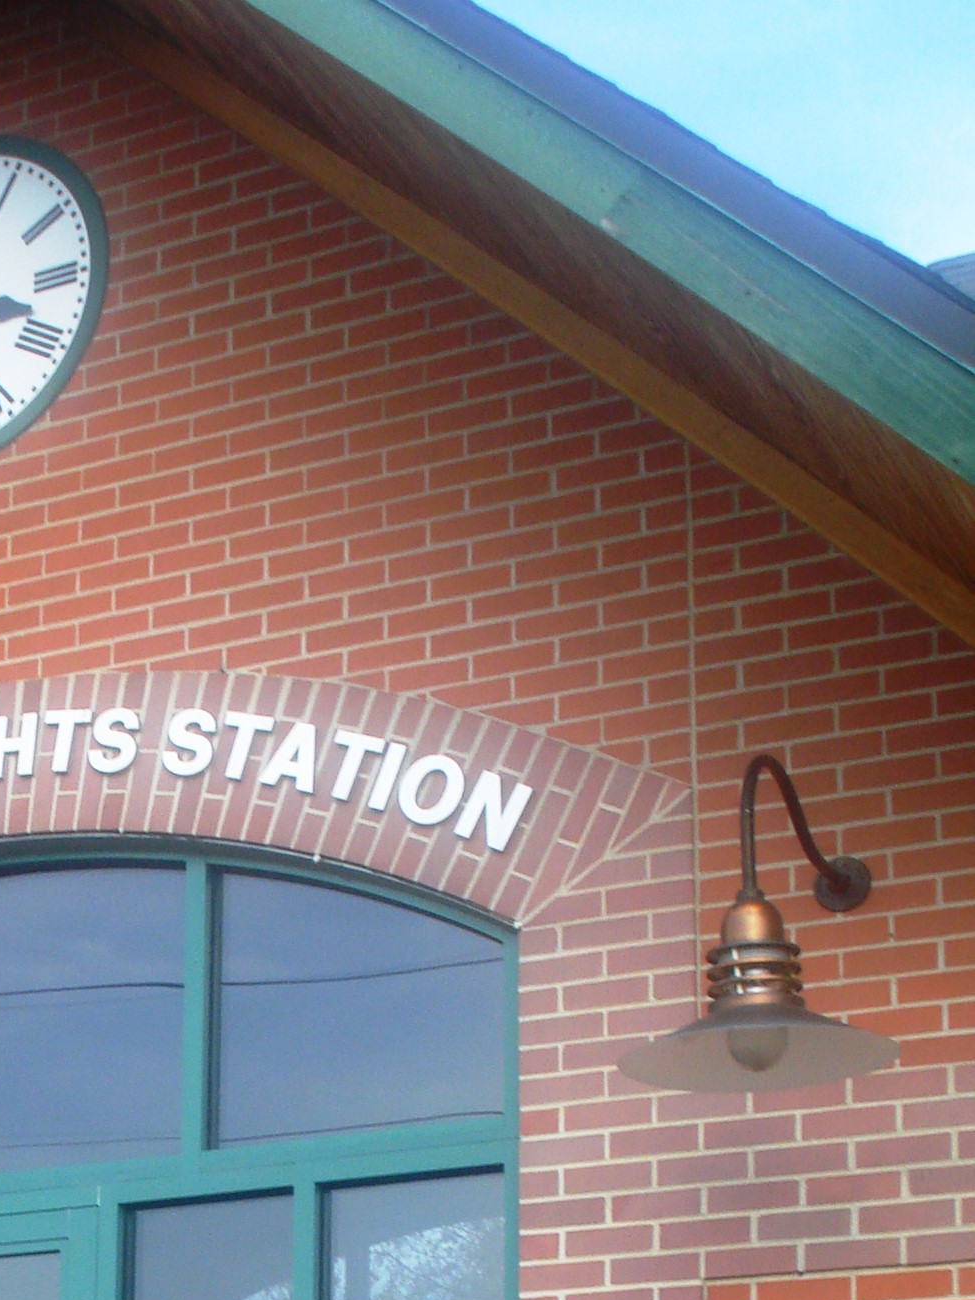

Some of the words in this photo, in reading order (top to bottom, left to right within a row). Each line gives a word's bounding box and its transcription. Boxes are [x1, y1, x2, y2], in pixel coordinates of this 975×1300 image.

[21, 203, 64, 245] II
[33, 261, 78, 293] III
[161, 708, 534, 853] STATION
